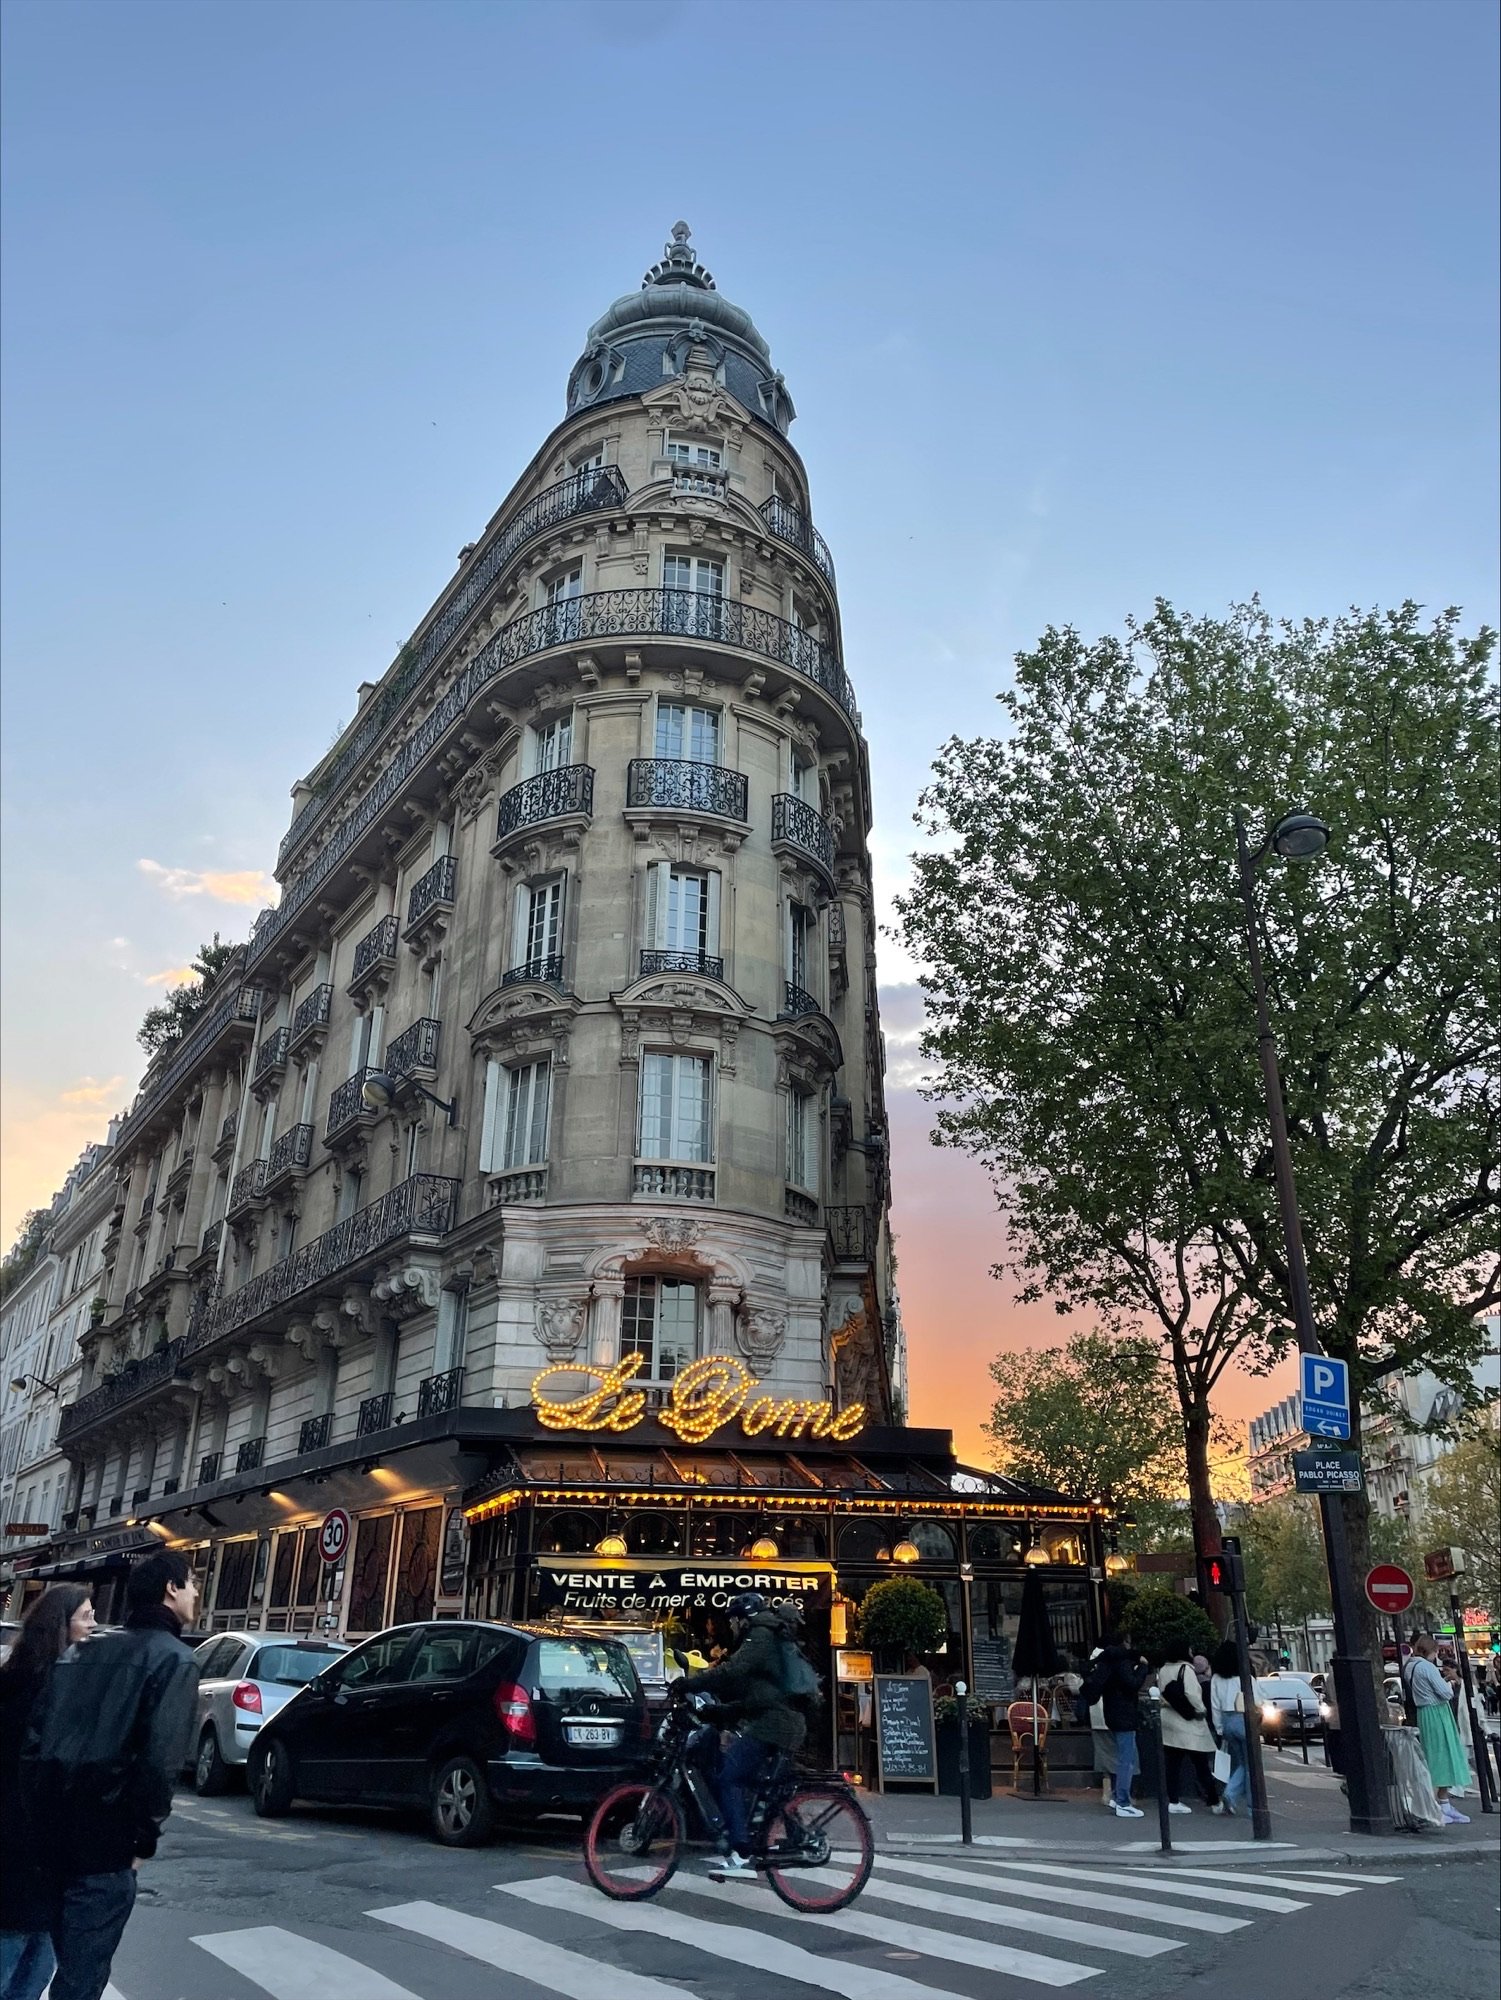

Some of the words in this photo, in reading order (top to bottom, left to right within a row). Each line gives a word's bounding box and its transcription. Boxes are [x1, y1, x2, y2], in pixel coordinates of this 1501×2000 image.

[1314, 1365, 1335, 1395] P
[531, 1352, 645, 1432] Le
[1298, 1470, 1324, 1479] PABLO
[1326, 1470, 1360, 1479] PICASSO
[1315, 1461, 1341, 1470] PLACE
[324, 1523, 343, 1548] 30
[551, 1573, 636, 1589] VENTE
[680, 1573, 819, 1591] EMPORTER
[563, 1591, 618, 1609] Fruits
[621, 1592, 647, 1609] de
[650, 1594, 691, 1608] mer
[693, 1593, 706, 1607] &
[711, 1591, 805, 1610] Cracés
